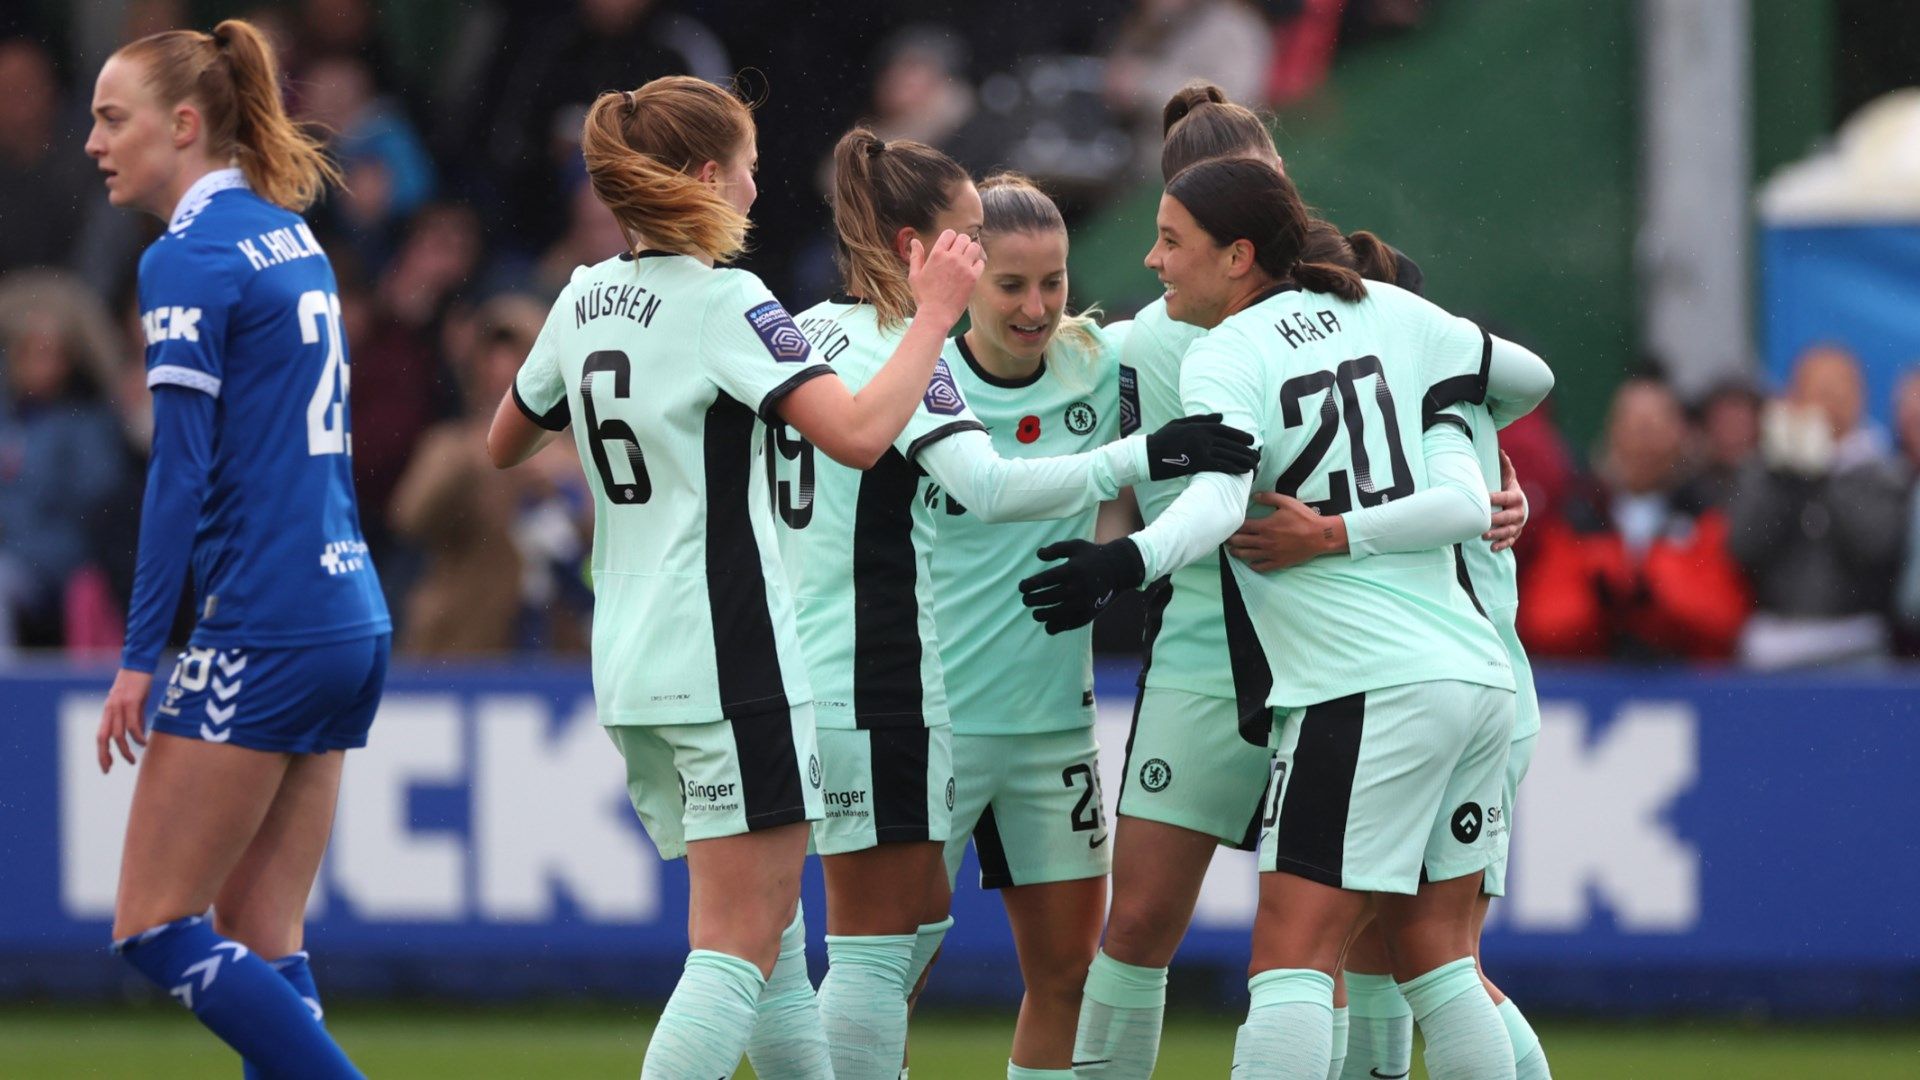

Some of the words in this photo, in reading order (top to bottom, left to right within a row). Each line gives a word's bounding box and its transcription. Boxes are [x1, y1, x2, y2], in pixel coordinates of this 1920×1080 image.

[575, 281, 662, 330] NÜSKEN
[580, 350, 652, 505] 6
[1276, 355, 1415, 516] 20
[687, 780, 736, 801] Singer
[708, 802, 739, 811] Markets
[823, 789, 866, 807] inger
